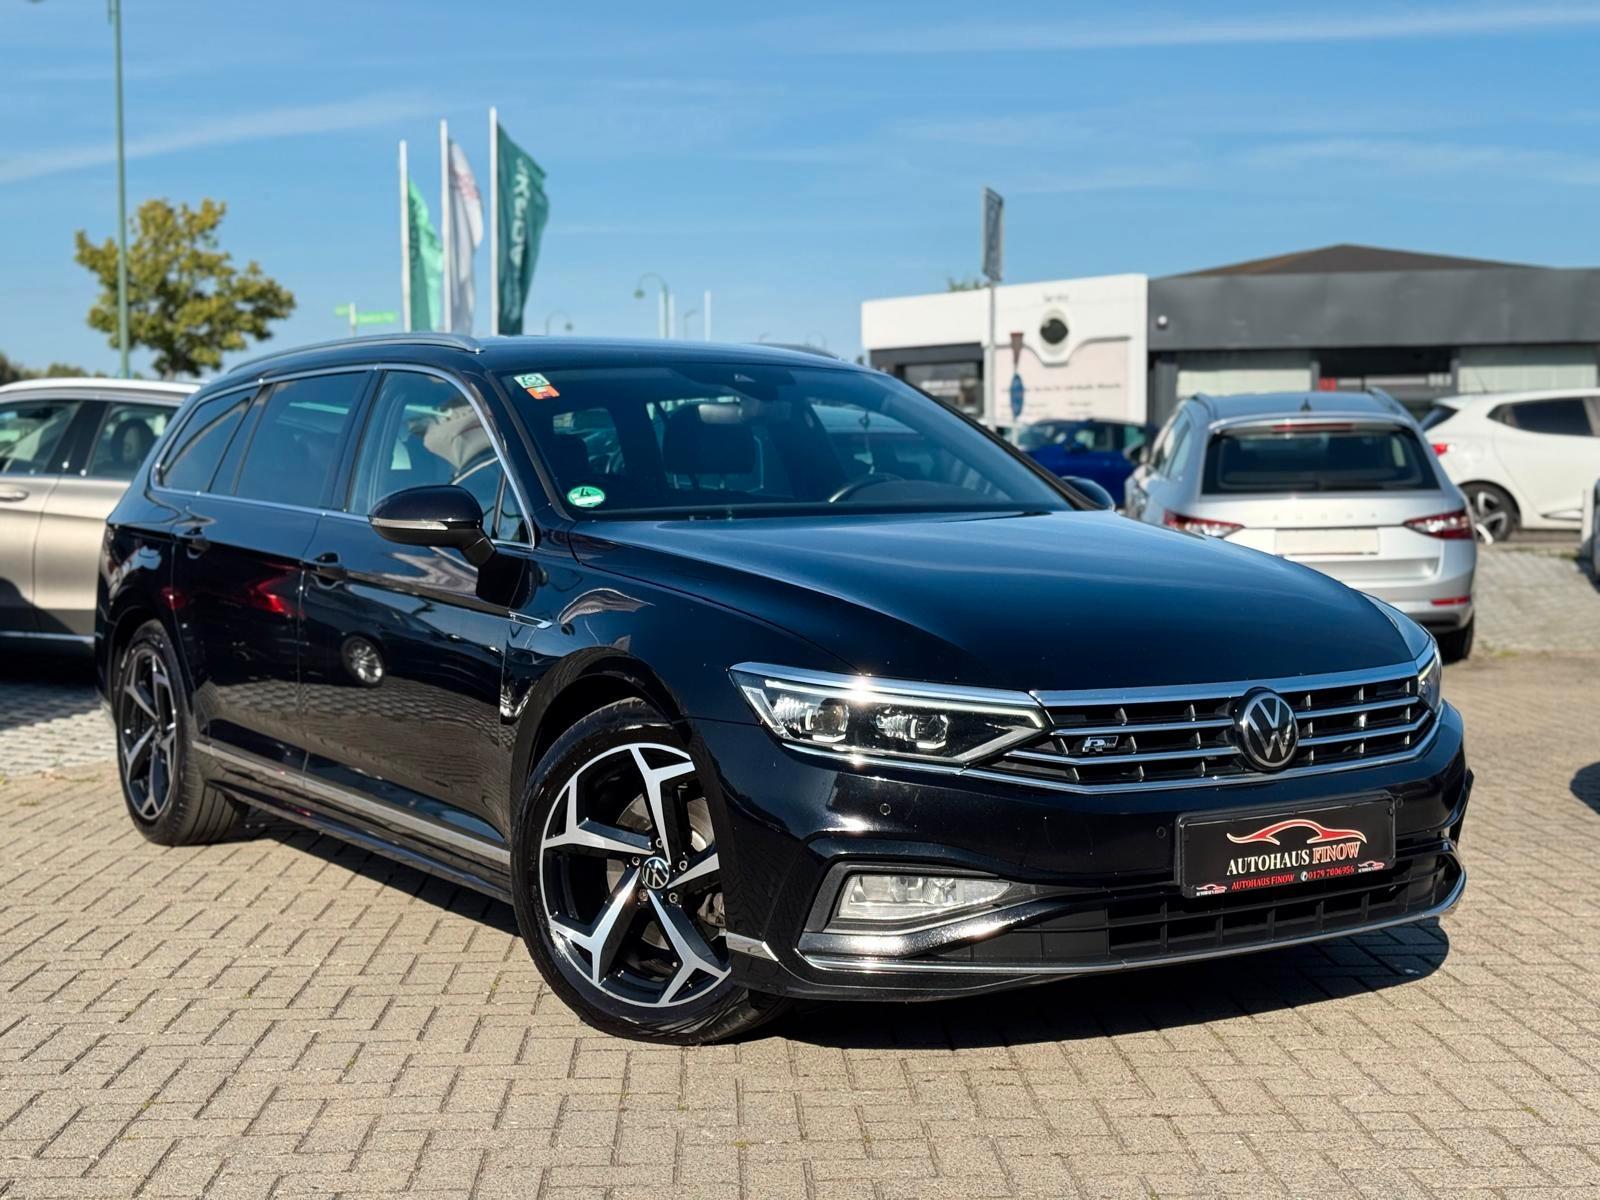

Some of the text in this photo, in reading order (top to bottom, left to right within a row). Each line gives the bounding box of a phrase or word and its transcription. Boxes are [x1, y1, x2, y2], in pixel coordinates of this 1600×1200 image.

[1226, 841, 1361, 876] AUTOHAUS FINOW
[1231, 877, 1271, 891] AUTOHAUS
[1271, 873, 1295, 885] FINOW
